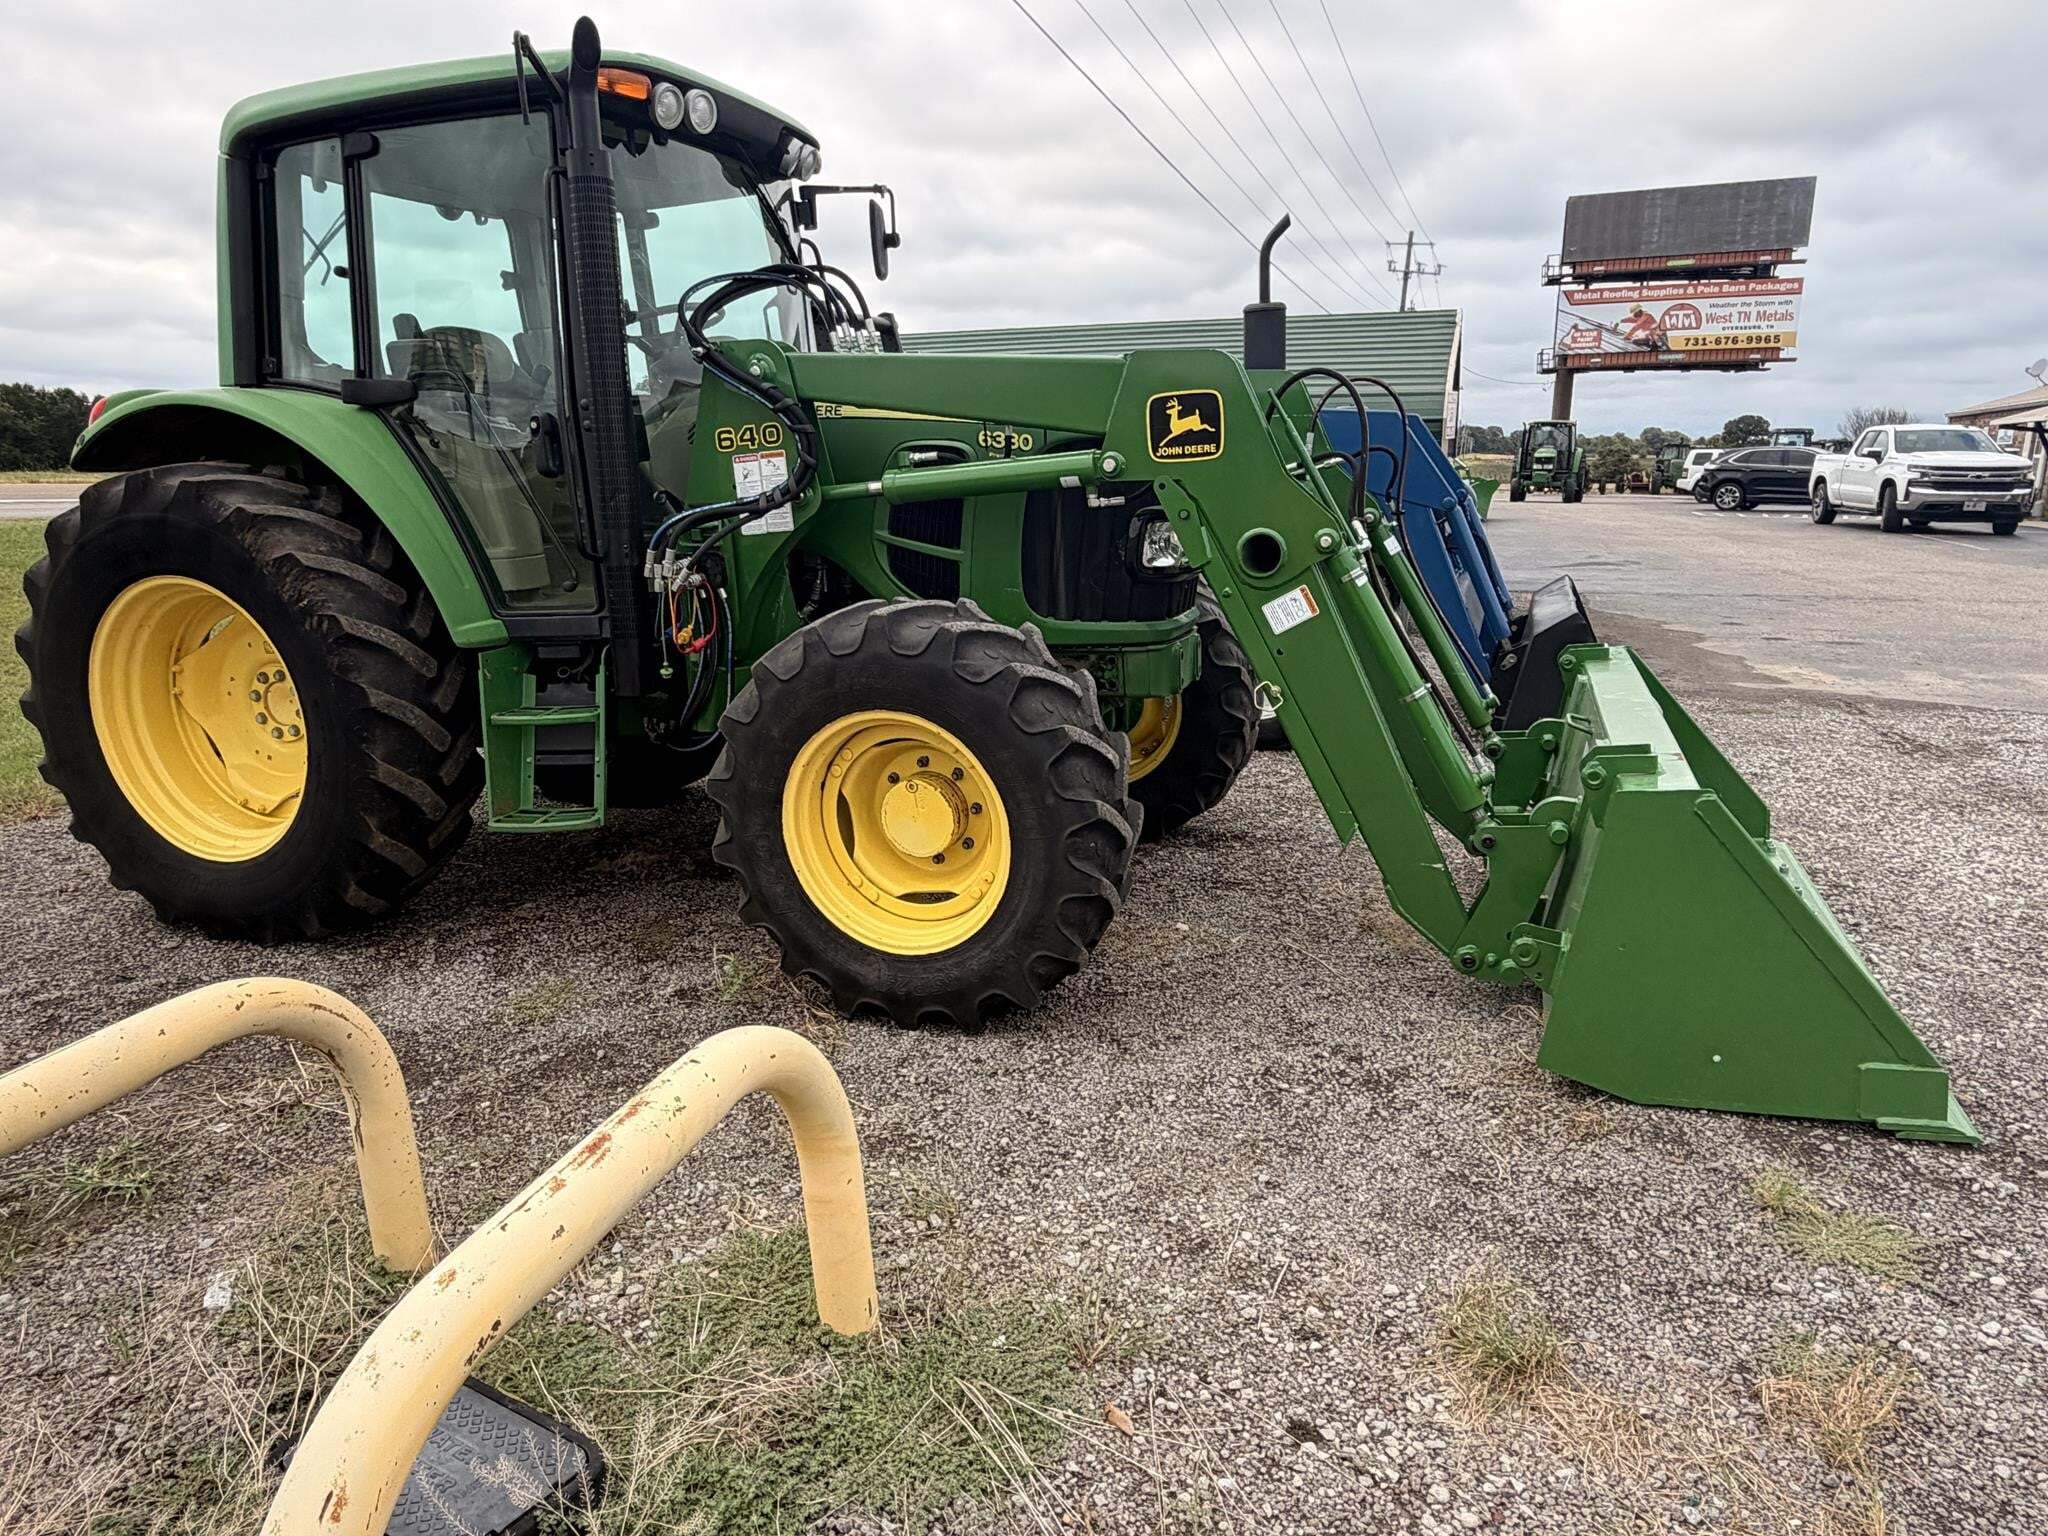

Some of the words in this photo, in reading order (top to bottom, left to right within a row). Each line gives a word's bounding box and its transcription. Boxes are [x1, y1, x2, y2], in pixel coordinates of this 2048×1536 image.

[1573, 291, 1601, 301] Metal
[1602, 289, 1640, 299] Roofing
[1641, 287, 1684, 297] Supplies
[1686, 286, 1695, 294] &
[1696, 285, 1720, 294] Pole
[1722, 283, 1746, 293] Barn
[1748, 281, 1799, 291] Packages
[1709, 301, 1739, 309] Weather
[1705, 312, 1733, 325] West
[1736, 310, 1751, 323] TN
[1755, 308, 1795, 323] Metals
[1684, 334, 1782, 347] 731-676-9965
[815, 405, 843, 416] ERE
[715, 421, 783, 452] 640
[1155, 445, 1183, 457] JOHN
[1184, 443, 1217, 455] DEERE
